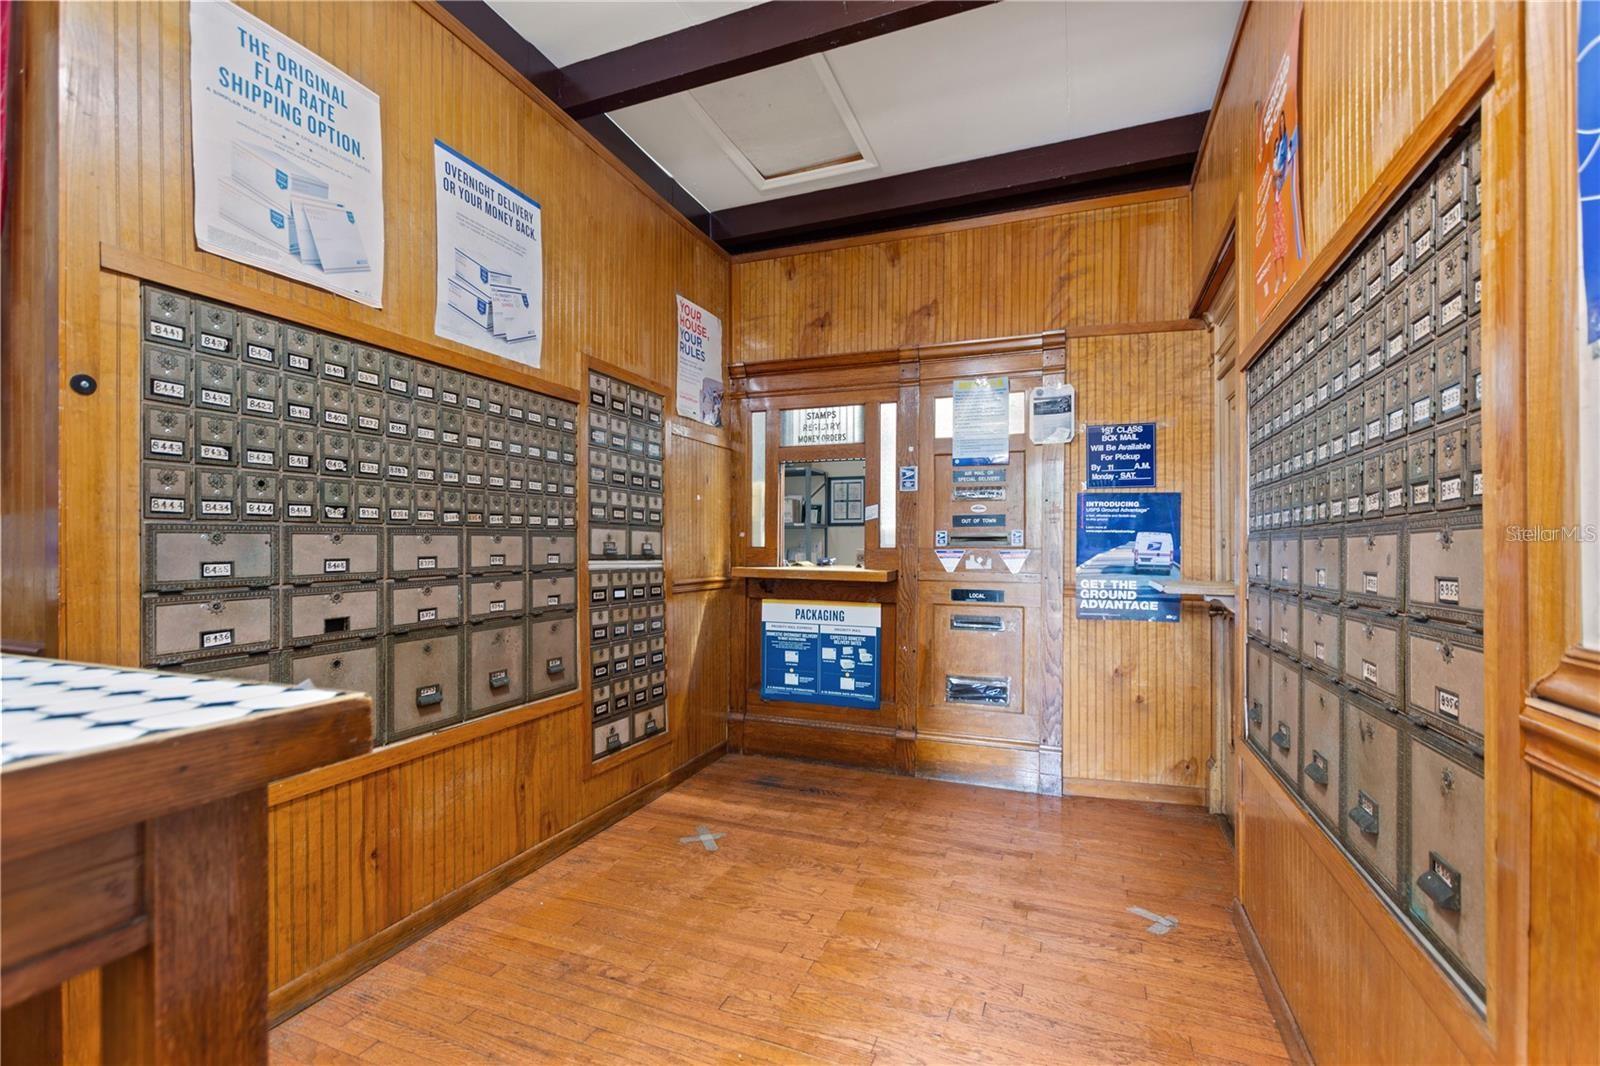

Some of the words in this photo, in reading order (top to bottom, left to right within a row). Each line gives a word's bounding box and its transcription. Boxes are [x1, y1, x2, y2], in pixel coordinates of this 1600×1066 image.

[237, 26, 271, 63] THE
[276, 52, 348, 110] ORIGINAL
[254, 61, 293, 98] FLAT
[299, 85, 336, 123] RATE
[218, 66, 302, 127] SHIPPING
[307, 115, 365, 160] OPTION.
[444, 161, 495, 202] OVERNIGHT
[497, 192, 534, 224] DELIVERY
[443, 177, 457, 196] OR
[458, 186, 483, 211] YOUR
[485, 199, 513, 228] MONEY
[515, 216, 537, 242] BACK.
[680, 300, 702, 324] YOUR
[154, 325, 180, 338] 8441
[680, 317, 710, 342] HOUSE,
[680, 328, 703, 350] YOUR
[680, 341, 706, 362] RULES
[154, 381, 184, 396] 8442
[248, 399, 274, 411] 8422
[806, 411, 837, 420] STAMPS
[1101, 426, 1115, 434] 1ST
[1116, 425, 1144, 434] CLASS
[821, 433, 847, 442] ORDERS
[1101, 434, 1118, 442] BOX
[1119, 433, 1139, 441] MAIL
[151, 440, 183, 453] 8443
[1105, 444, 1117, 452] Be
[1117, 443, 1151, 451] Available
[1114, 453, 1141, 461] Pickup
[1091, 464, 1101, 473] By
[1091, 473, 1115, 481] Monday
[151, 499, 184, 512] 8444
[203, 502, 231, 513] 8434
[247, 504, 274, 514] 8424
[1080, 579, 1108, 589] GET
[1110, 580, 1137, 589] THE
[1080, 590, 1138, 600] GROUND
[1080, 600, 1159, 611] ADVANTAGE
[795, 608, 845, 622] PACKAGING
[205, 634, 231, 645] 8436
